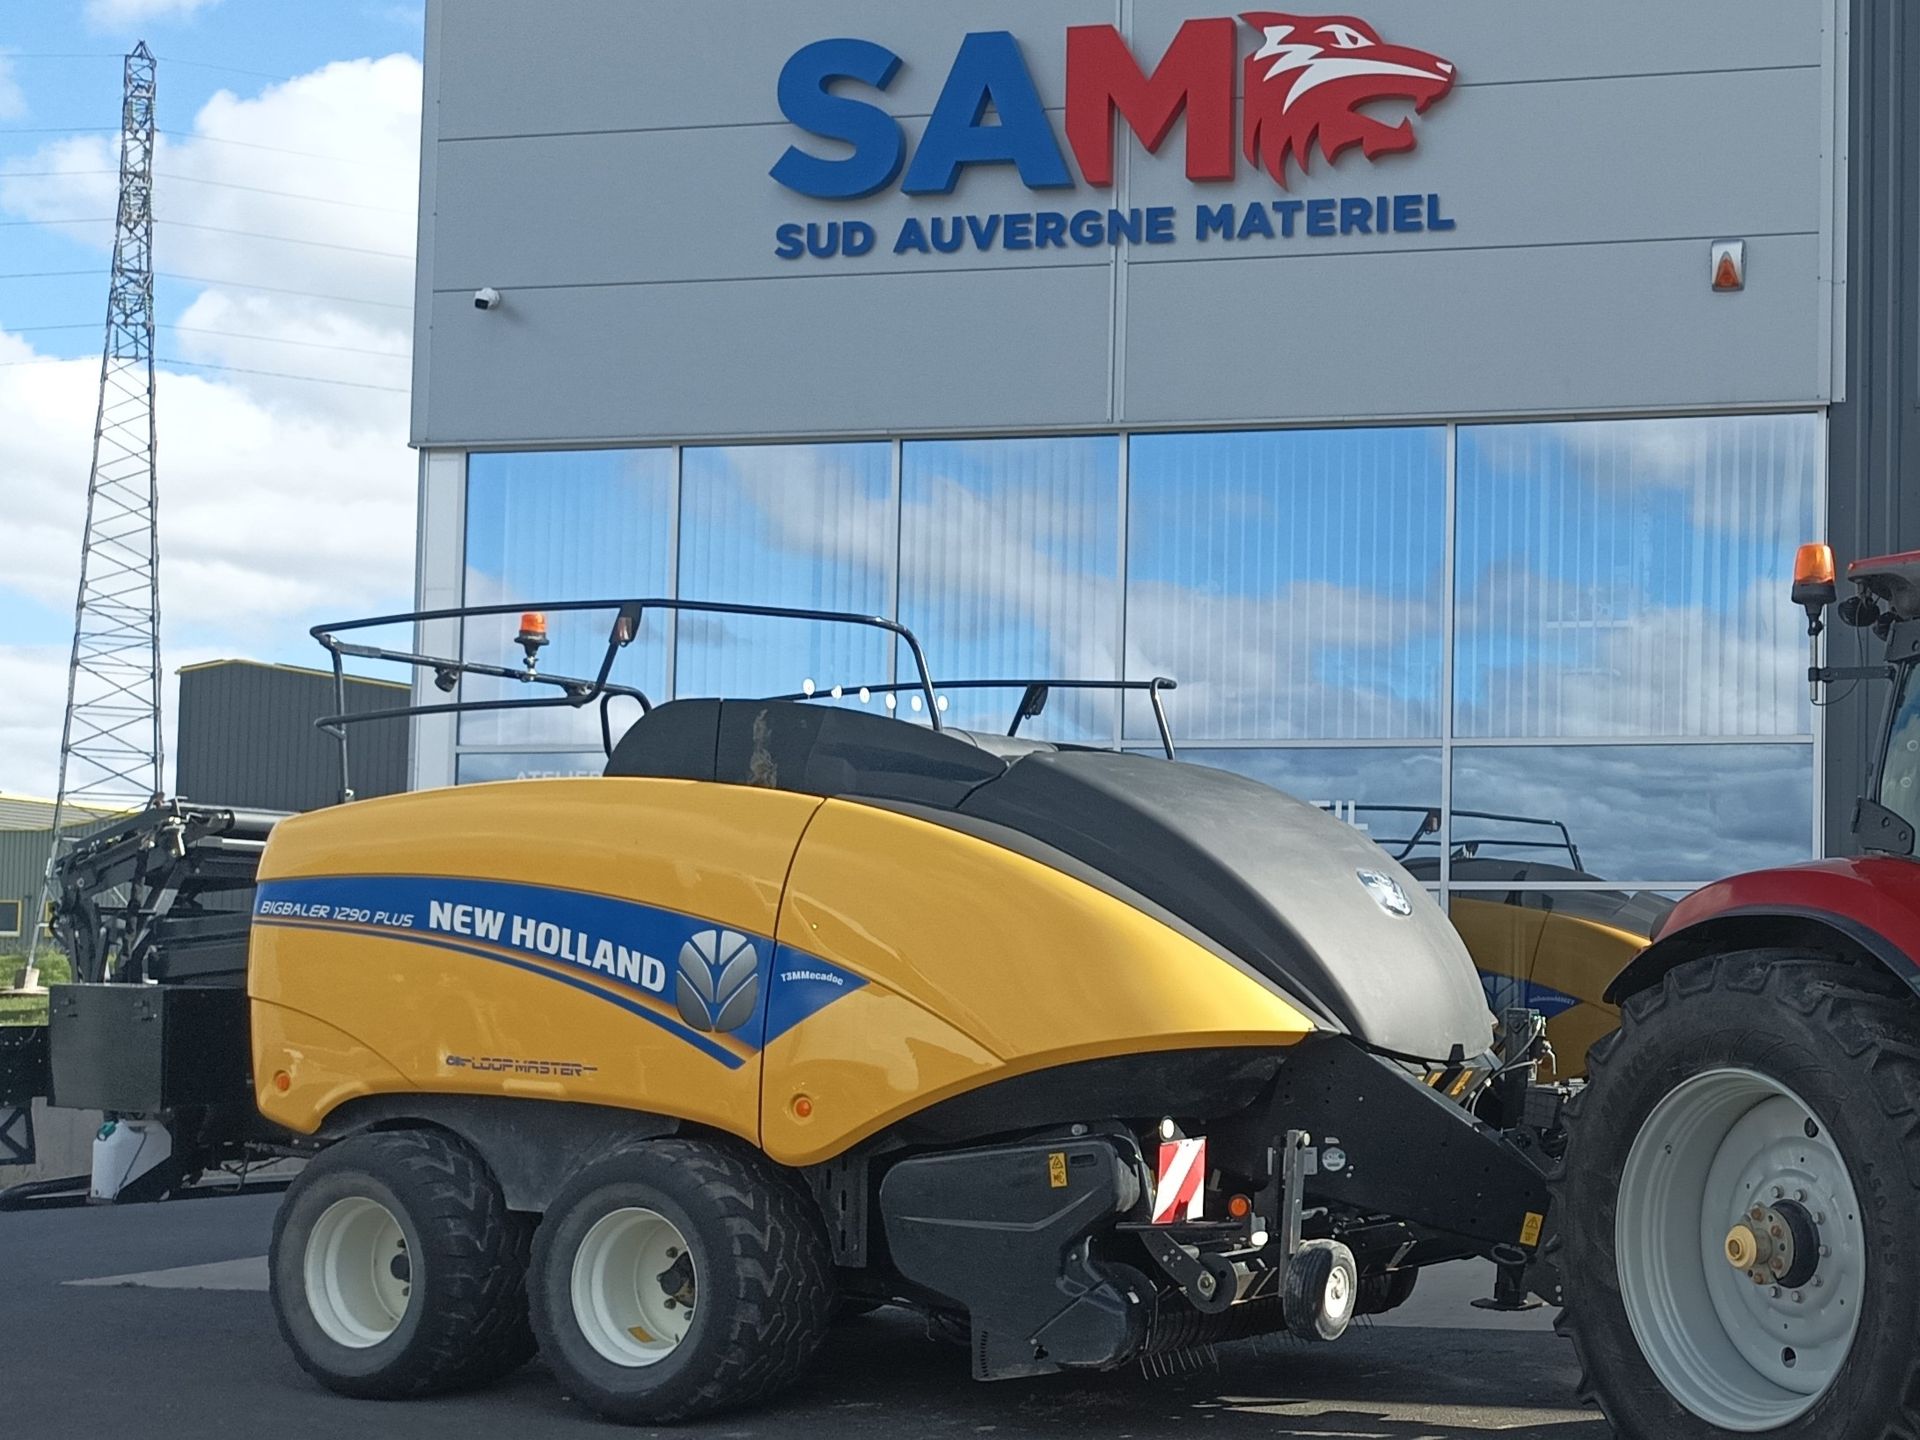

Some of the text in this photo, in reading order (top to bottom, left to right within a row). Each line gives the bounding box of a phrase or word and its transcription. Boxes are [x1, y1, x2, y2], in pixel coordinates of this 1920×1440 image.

[769, 17, 1237, 199] SAM
[774, 193, 1456, 260] SUD AUVERGNE MATERIEL
[259, 900, 415, 927] BIGBALER 1290 PLUS
[428, 900, 667, 993] NEW HOLLAND
[471, 1056, 583, 1077] LOOPMASTER
